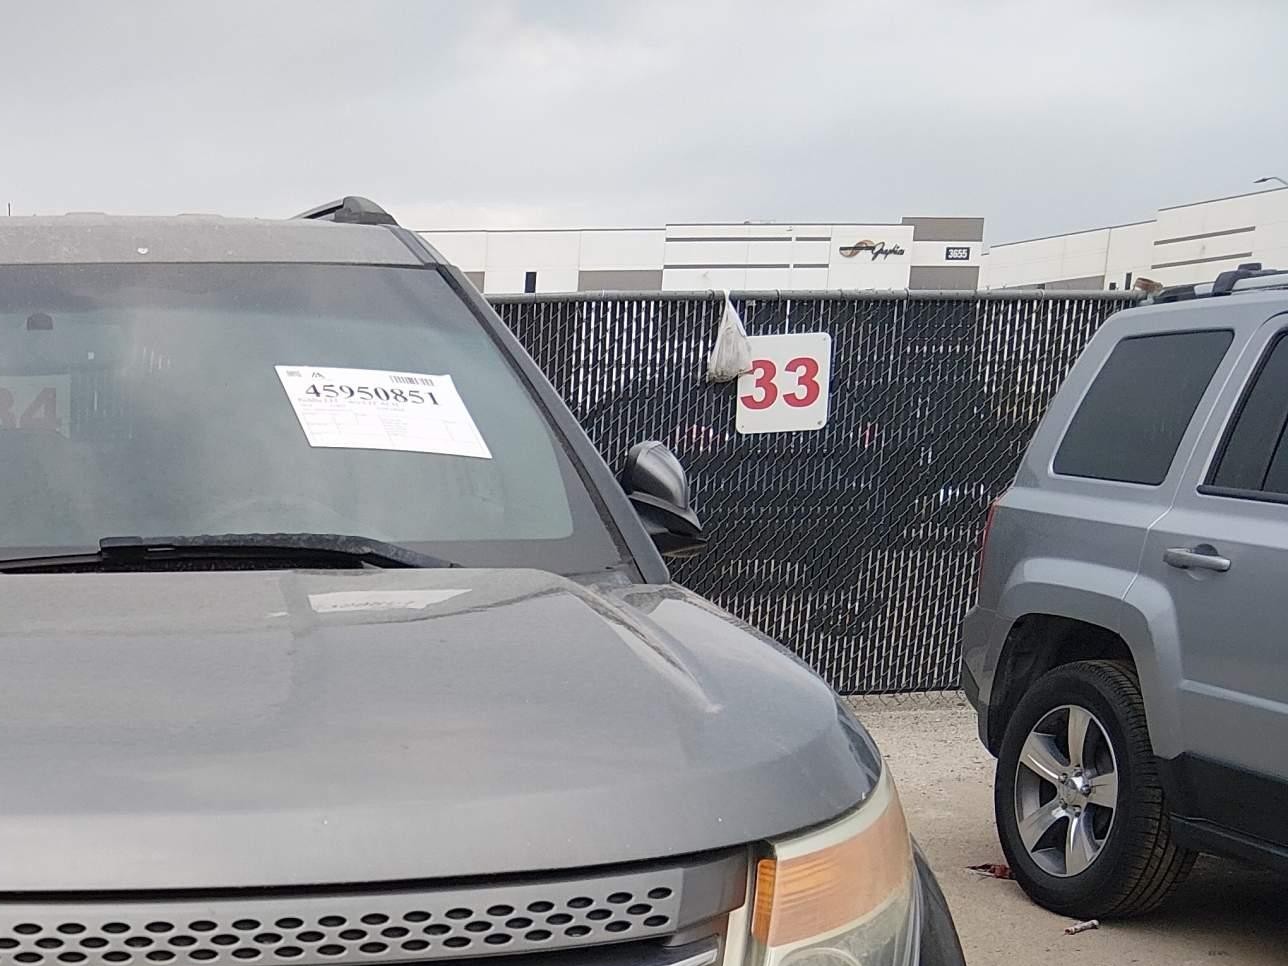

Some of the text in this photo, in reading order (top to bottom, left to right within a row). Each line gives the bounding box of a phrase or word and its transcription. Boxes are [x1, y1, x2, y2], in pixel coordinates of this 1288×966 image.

[947, 248, 968, 259] 3655
[305, 383, 440, 406] 45950851
[740, 357, 820, 410] 33
